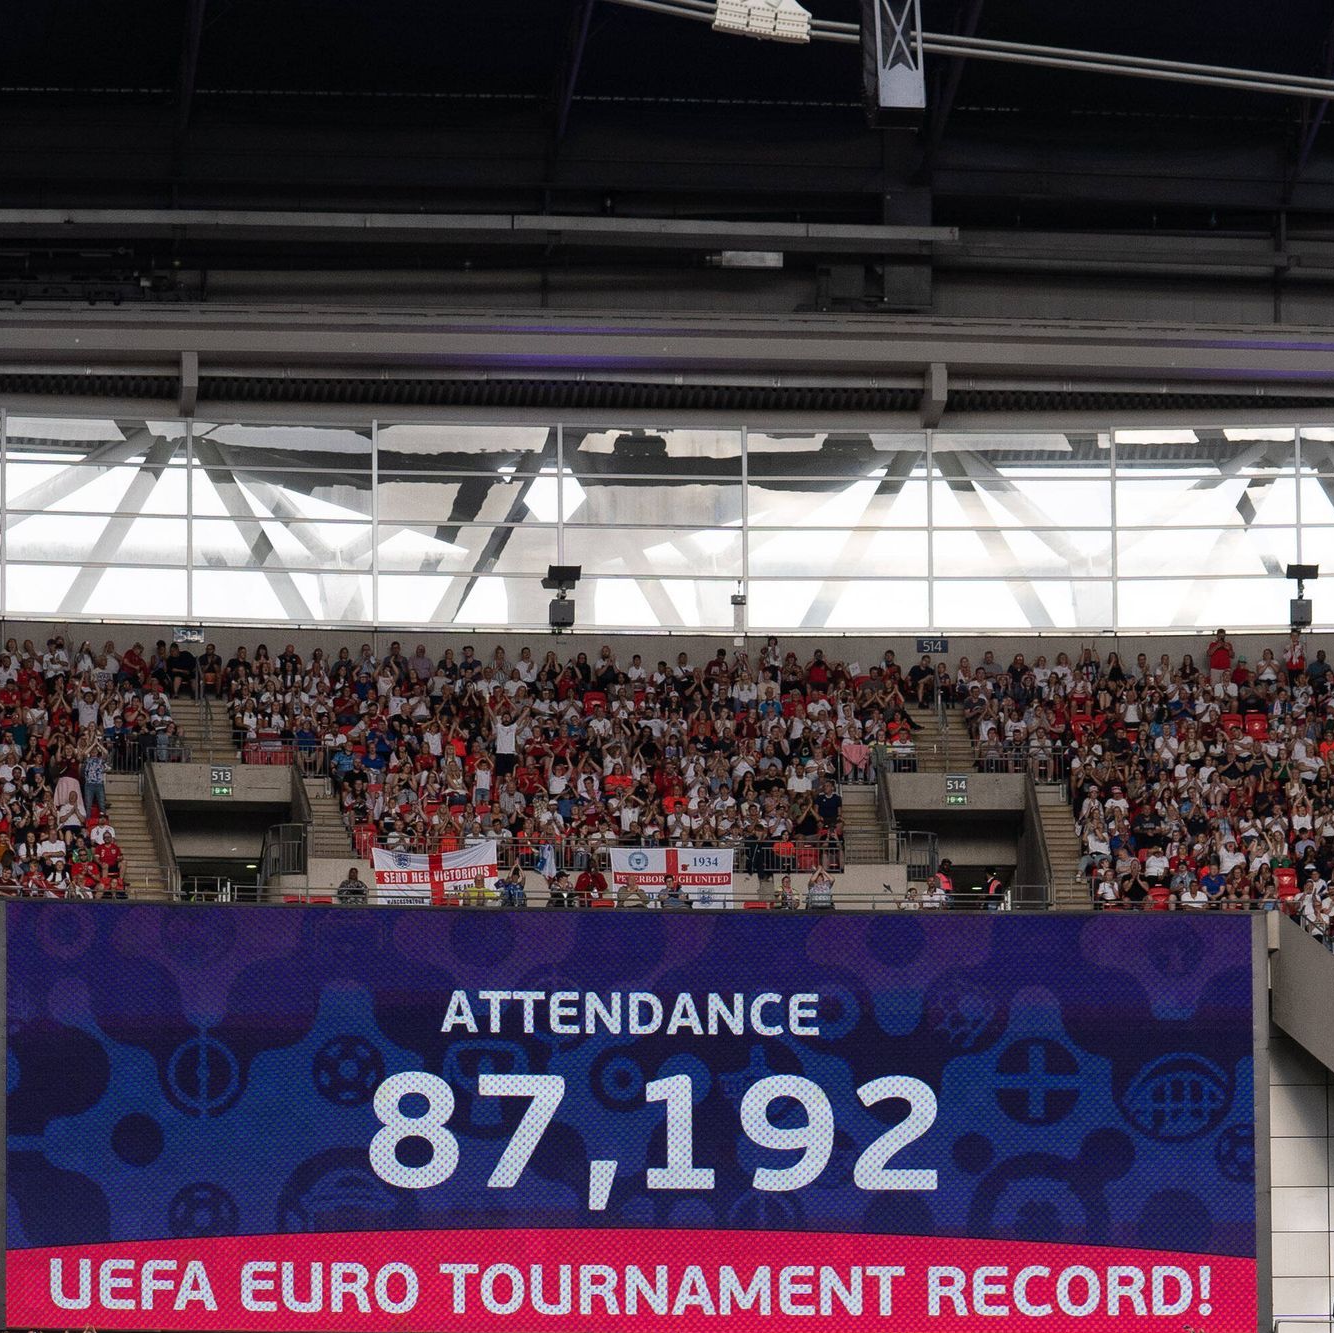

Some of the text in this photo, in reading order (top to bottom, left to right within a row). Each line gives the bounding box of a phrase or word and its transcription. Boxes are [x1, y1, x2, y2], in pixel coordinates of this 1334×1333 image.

[922, 640, 942, 651] 514
[212, 772, 231, 781] 513
[946, 779, 966, 790] 514
[693, 857, 718, 867] 1934
[384, 865, 489, 883] SEND HER VICTORIOUS
[695, 874, 729, 883] UNITED
[441, 991, 819, 1035] ATTENDANCE
[369, 1072, 940, 1212] 87,192
[49, 1257, 1212, 1318] UEFA EURO TOURNAMENT RECORD!
